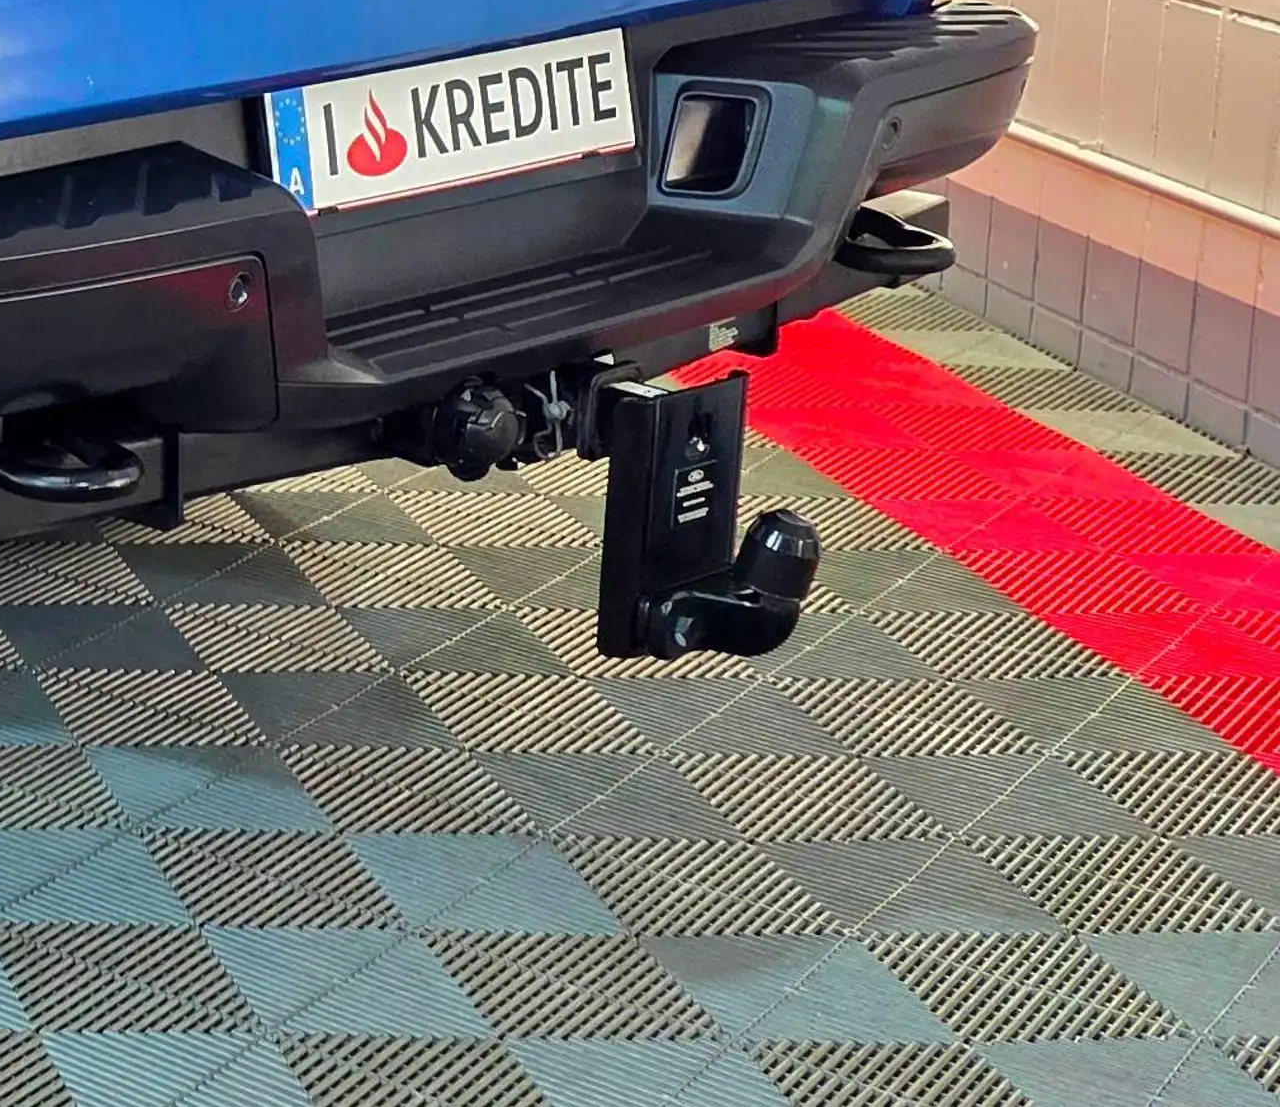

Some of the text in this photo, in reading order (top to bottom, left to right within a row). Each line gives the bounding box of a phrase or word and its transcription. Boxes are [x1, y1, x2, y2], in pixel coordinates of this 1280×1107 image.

[322, 51, 617, 177] I KREDITE
[289, 166, 305, 195] A
